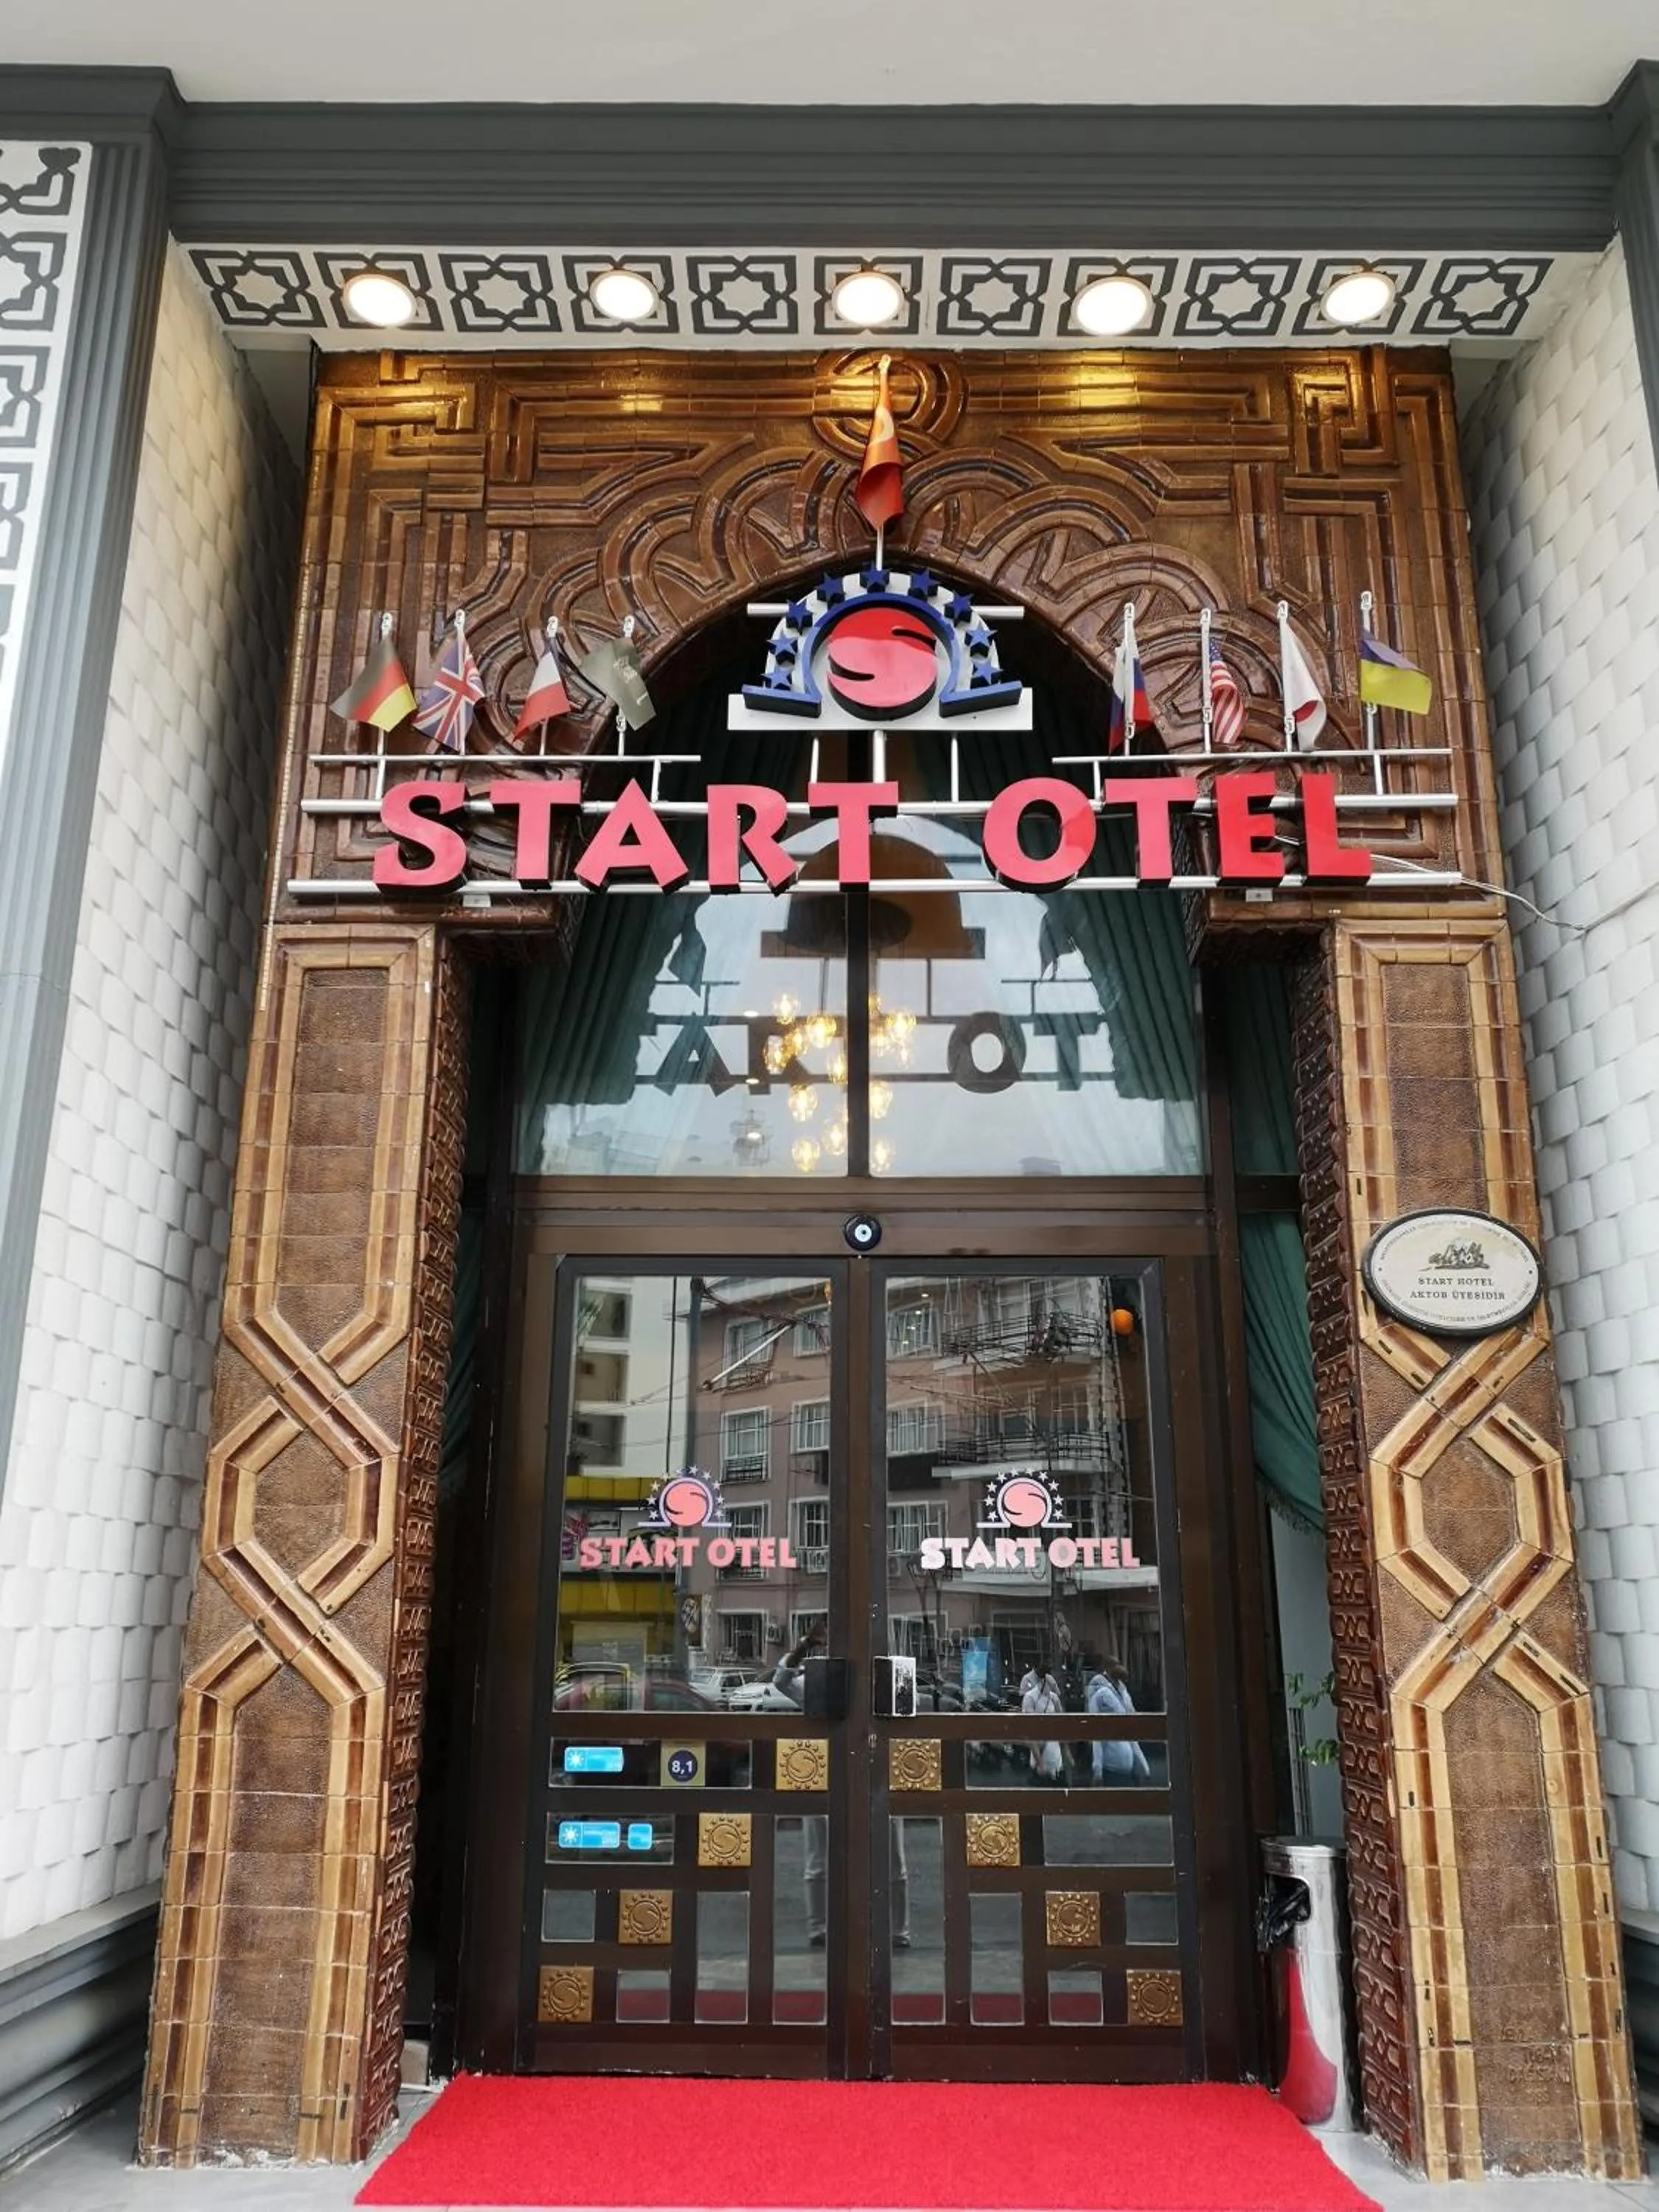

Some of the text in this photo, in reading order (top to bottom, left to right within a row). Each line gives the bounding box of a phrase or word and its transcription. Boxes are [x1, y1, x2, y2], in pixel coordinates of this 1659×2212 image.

[373, 772, 1374, 894] START OTEL
[1417, 1277, 1494, 1287] START HOTEL
[579, 1536, 797, 1569] START OTEL
[921, 1536, 1141, 1570] START OTEL
[672, 1760, 693, 1775] 8,1
